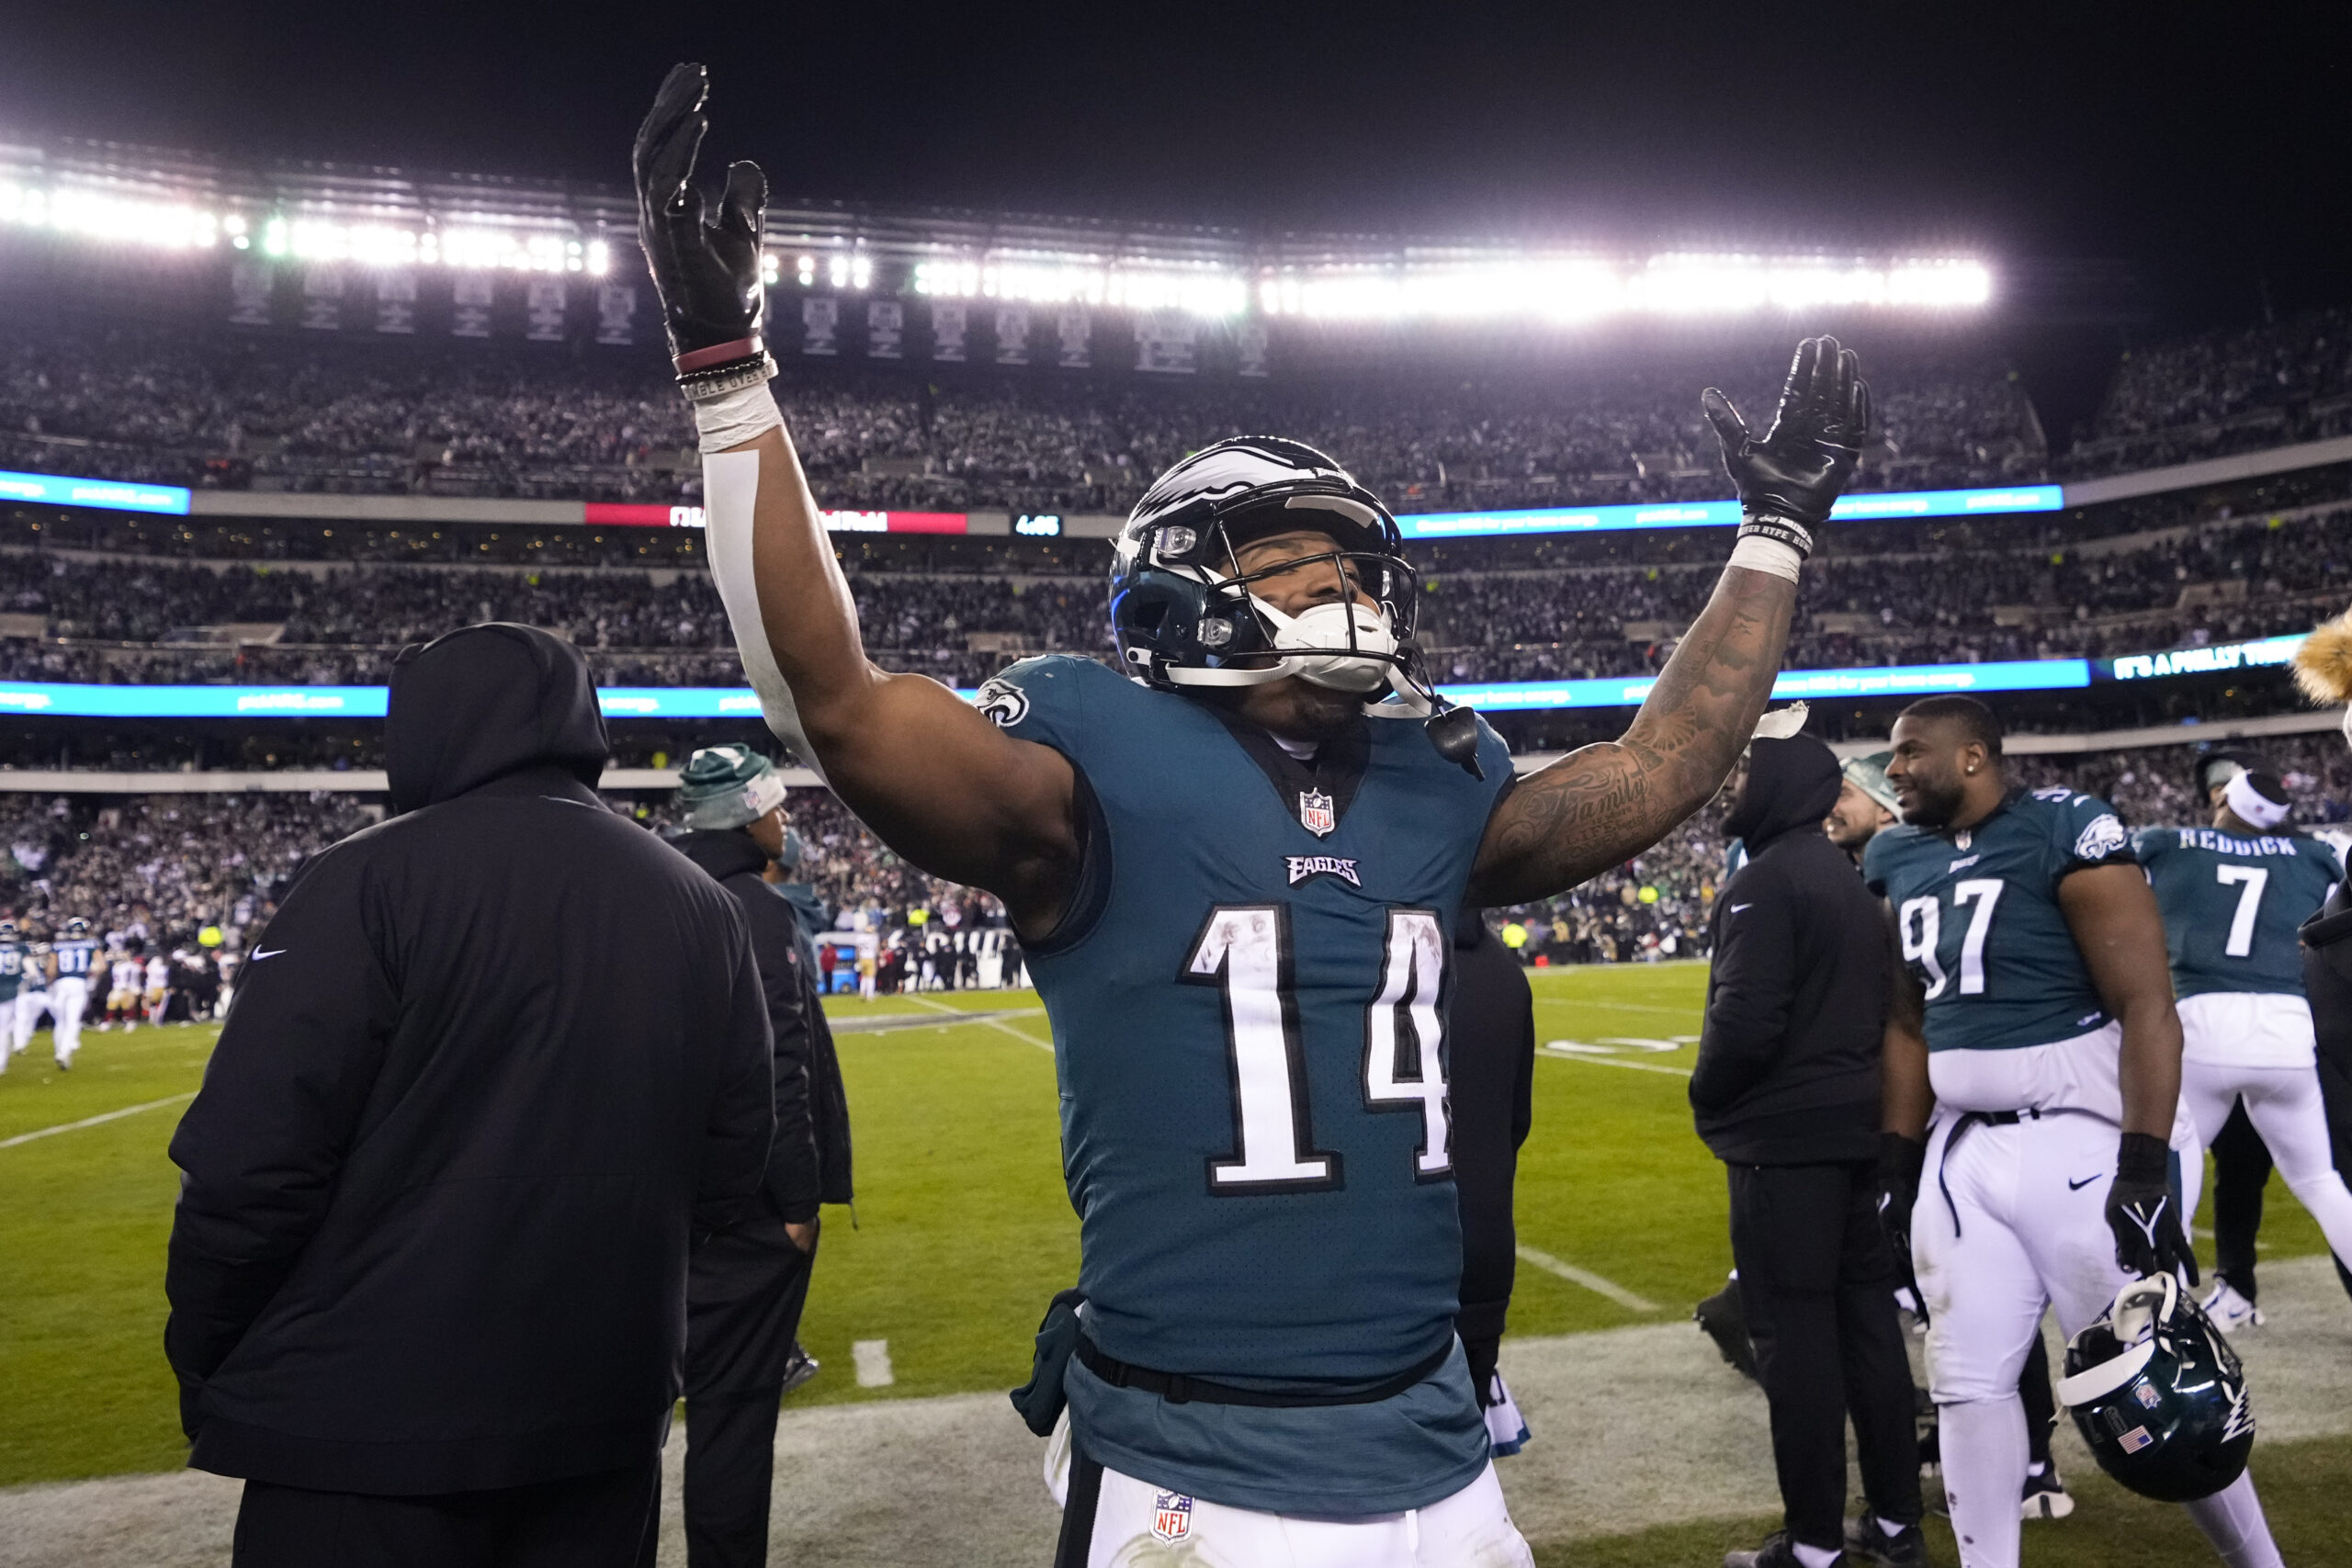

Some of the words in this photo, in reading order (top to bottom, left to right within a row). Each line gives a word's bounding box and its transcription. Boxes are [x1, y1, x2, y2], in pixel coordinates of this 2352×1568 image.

[1761, 526, 1789, 539] HYPE
[2154, 653, 2170, 674] A
[1307, 808, 1330, 828] NFL
[2179, 829, 2297, 856] REDDICK
[1285, 856, 1362, 886] EAGLES
[2217, 863, 2268, 956] 7
[1899, 878, 2004, 1000] 97
[1185, 906, 1452, 1185] 14
[1157, 1512, 1186, 1535] NFL
